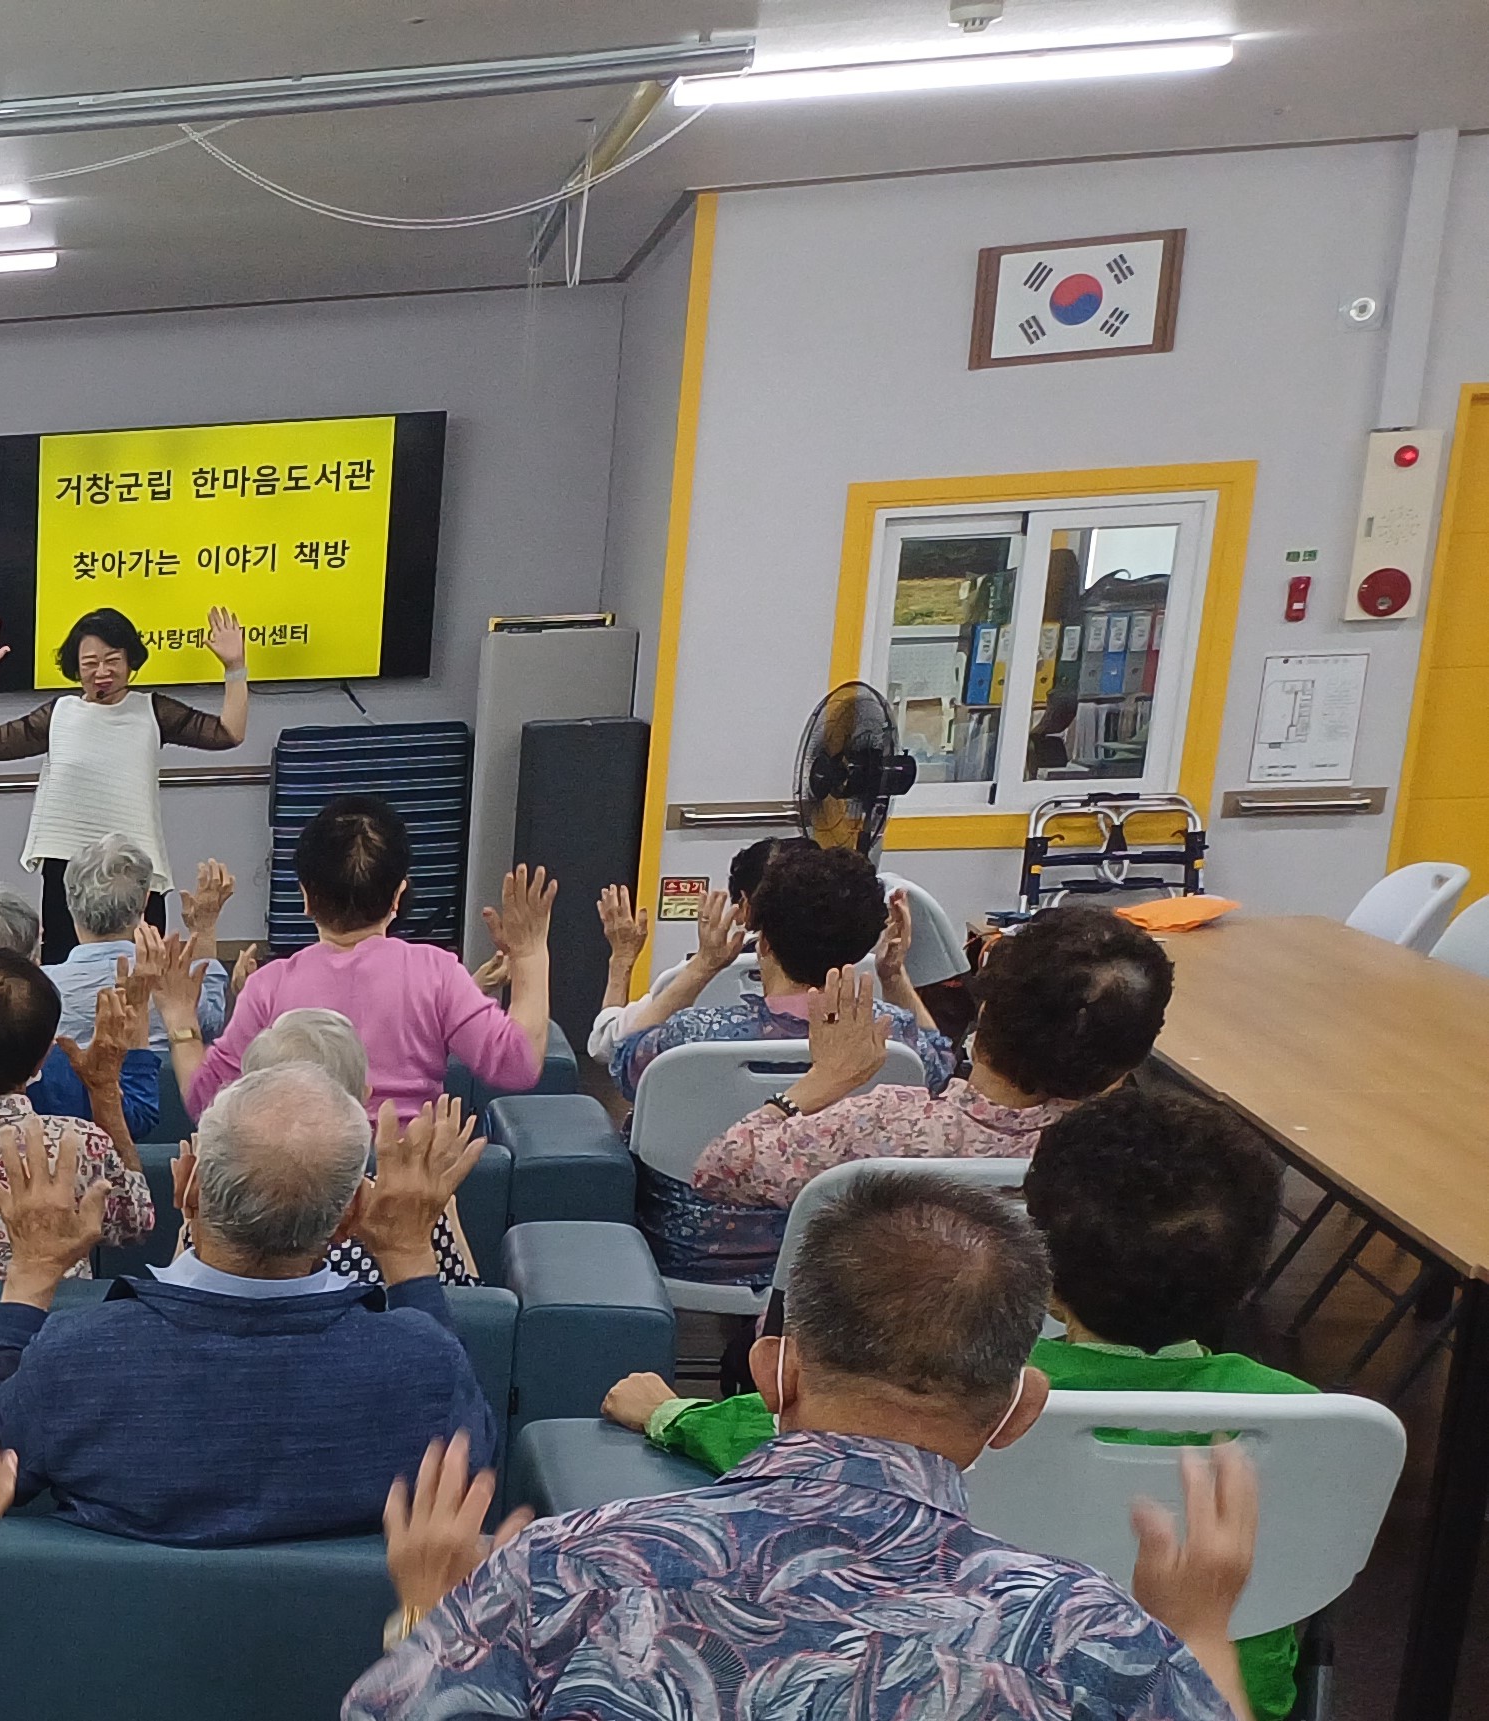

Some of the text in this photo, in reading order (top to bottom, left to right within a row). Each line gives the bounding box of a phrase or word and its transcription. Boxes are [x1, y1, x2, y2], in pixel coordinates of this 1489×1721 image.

[55, 459, 375, 505] 거창군립 한마음도서관
[72, 539, 351, 581] 찾아가는 이야기 책방
[138, 624, 309, 650] 사랑데어센터
